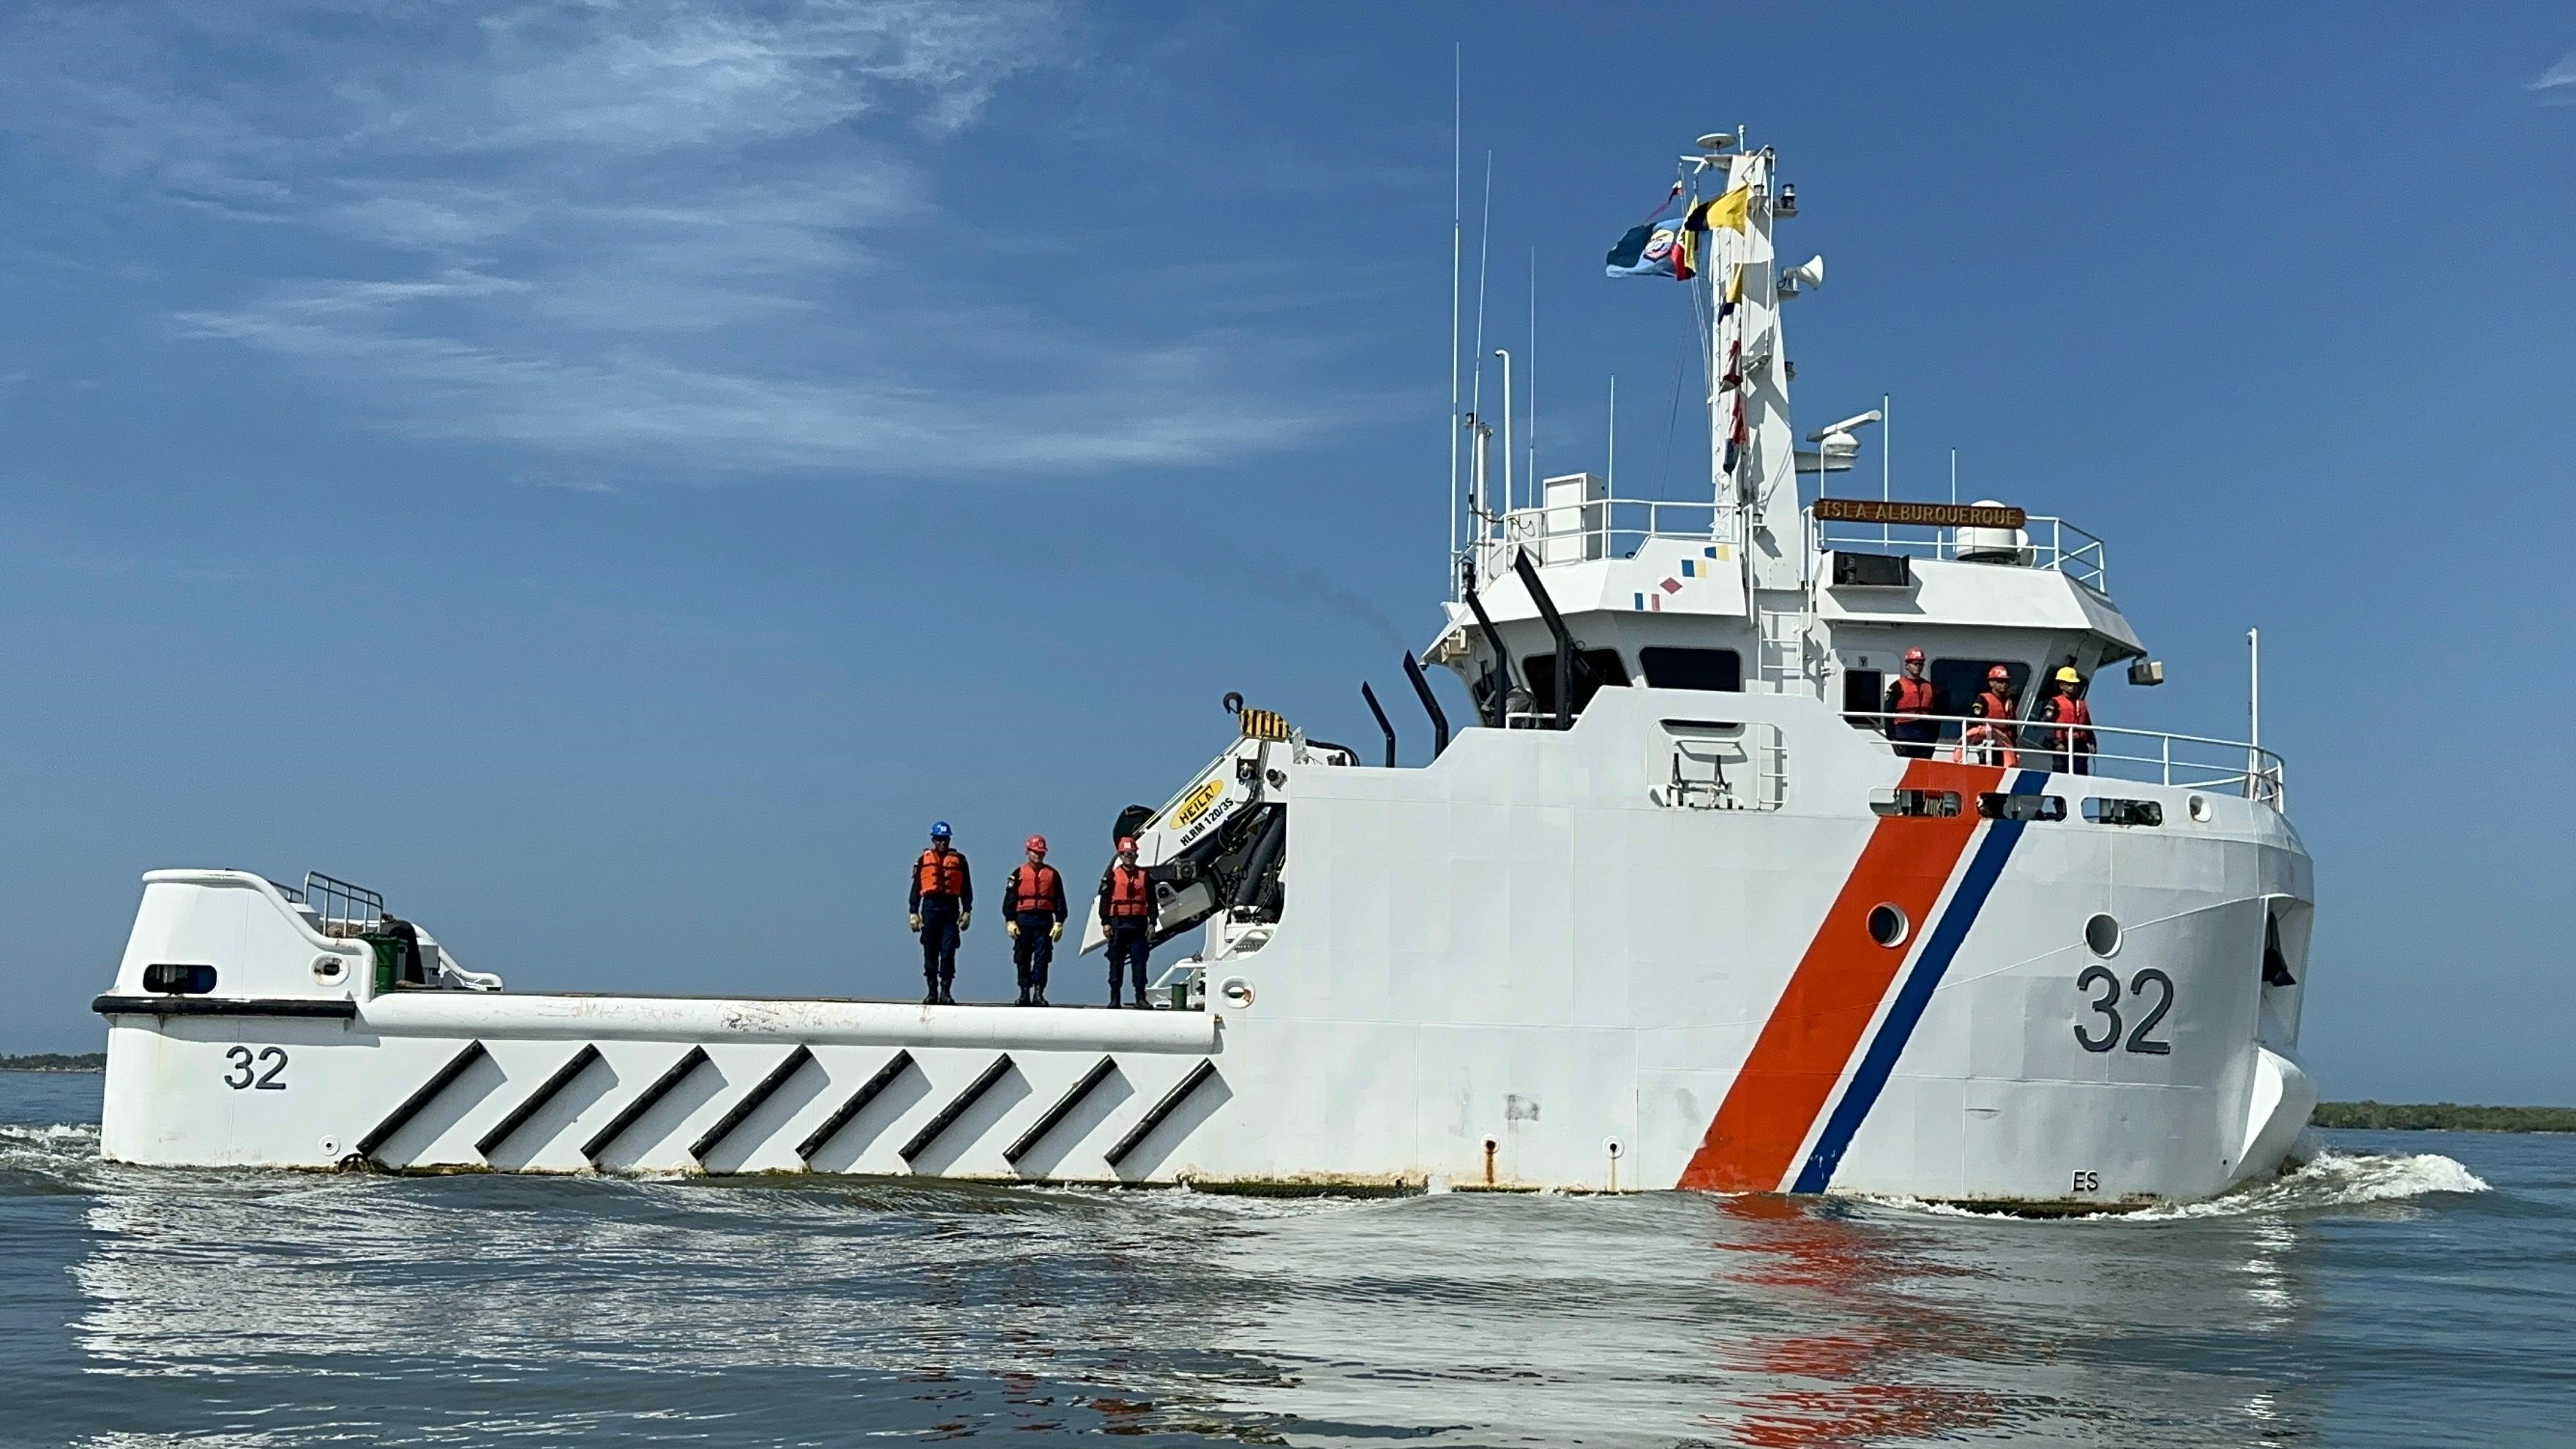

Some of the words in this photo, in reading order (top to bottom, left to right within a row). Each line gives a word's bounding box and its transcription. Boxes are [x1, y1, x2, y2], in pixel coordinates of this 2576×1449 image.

[1822, 500, 1867, 519] ISLA
[1875, 503, 2017, 525] ALBURQUERQUE
[1179, 792, 1214, 825] HEILA
[1180, 823, 1206, 846] HLRM
[2073, 965, 2174, 1055] 32
[224, 1045, 288, 1090] 32
[2073, 1171, 2098, 1191] ES
